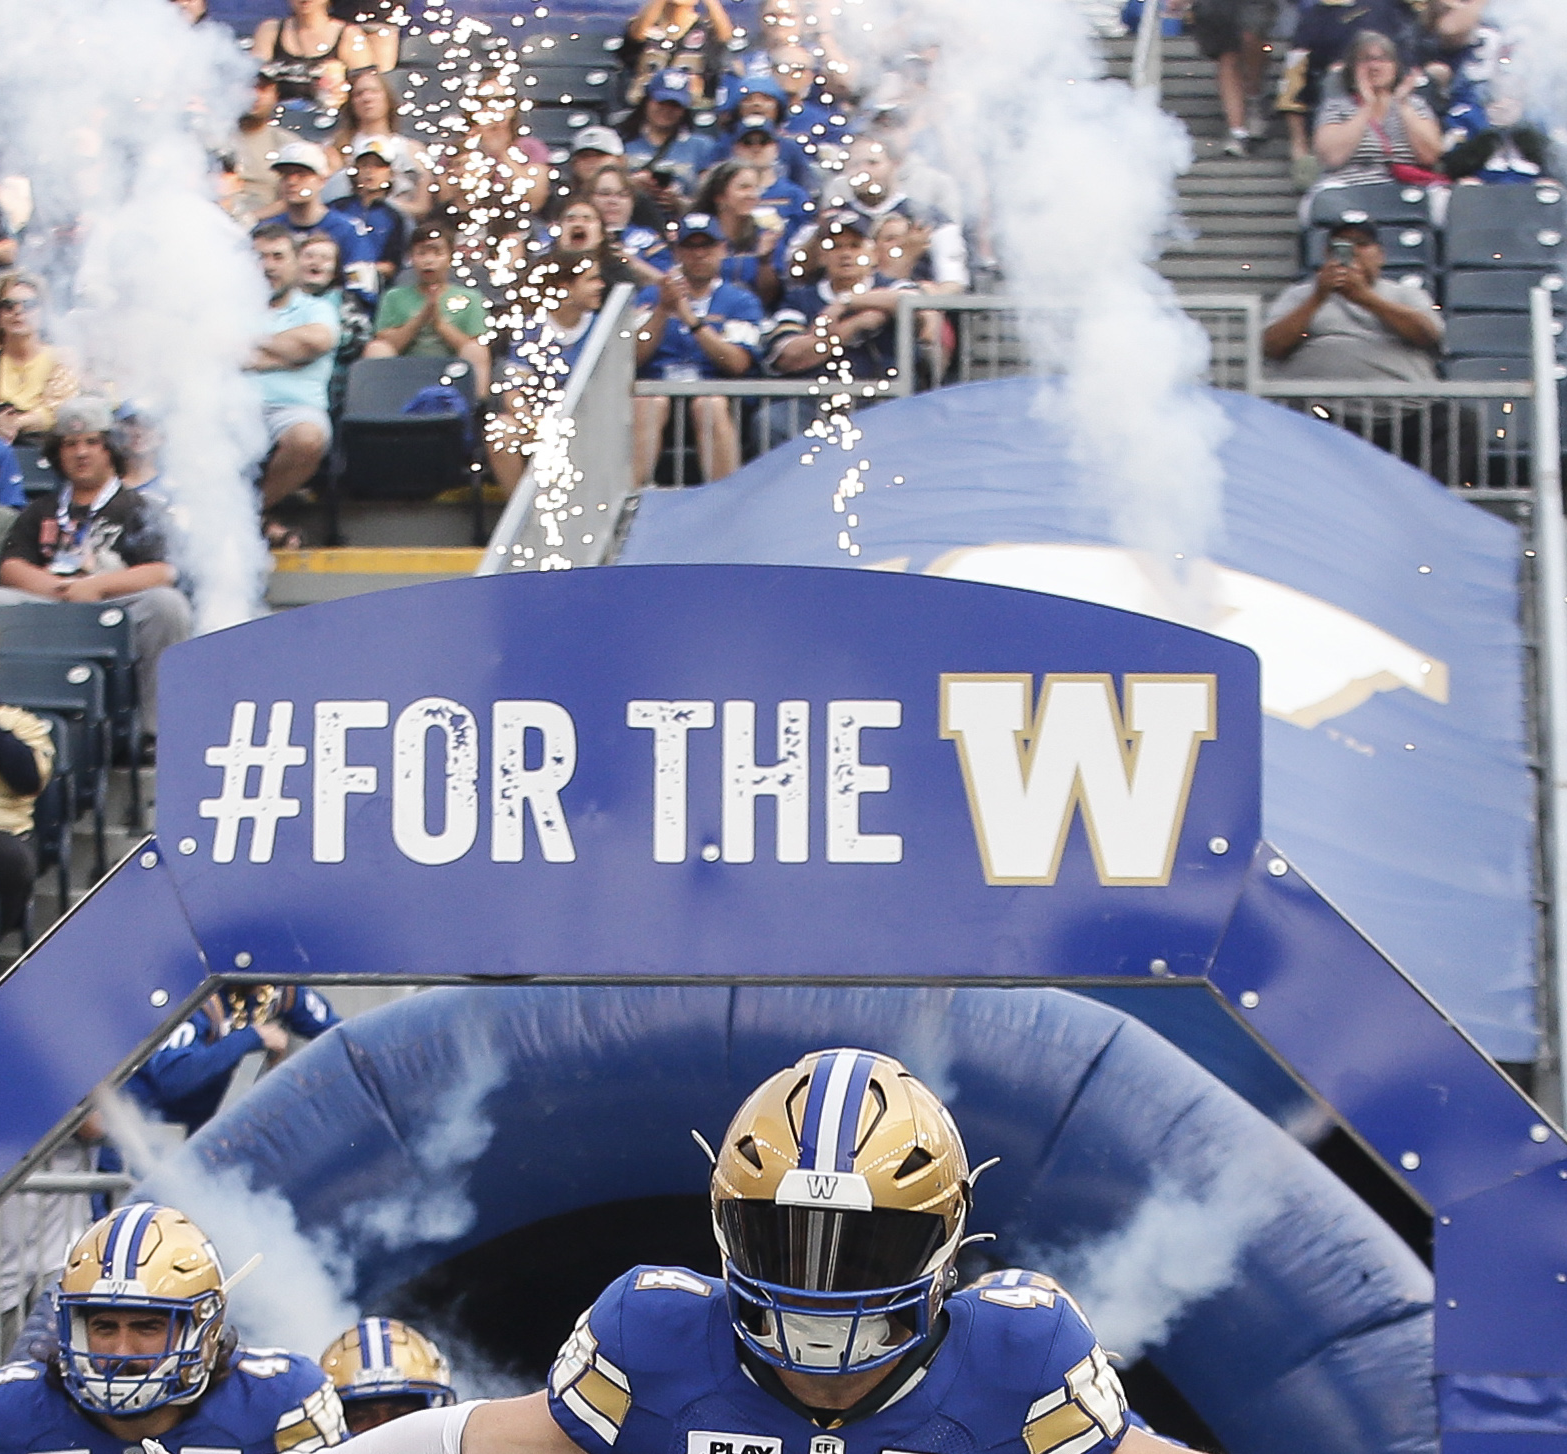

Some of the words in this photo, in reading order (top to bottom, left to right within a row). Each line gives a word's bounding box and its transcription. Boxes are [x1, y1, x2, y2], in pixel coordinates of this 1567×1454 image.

[199, 695, 577, 866] #FOR
[627, 698, 903, 865] THE
[939, 672, 1218, 886] W
[805, 1174, 839, 1200] W
